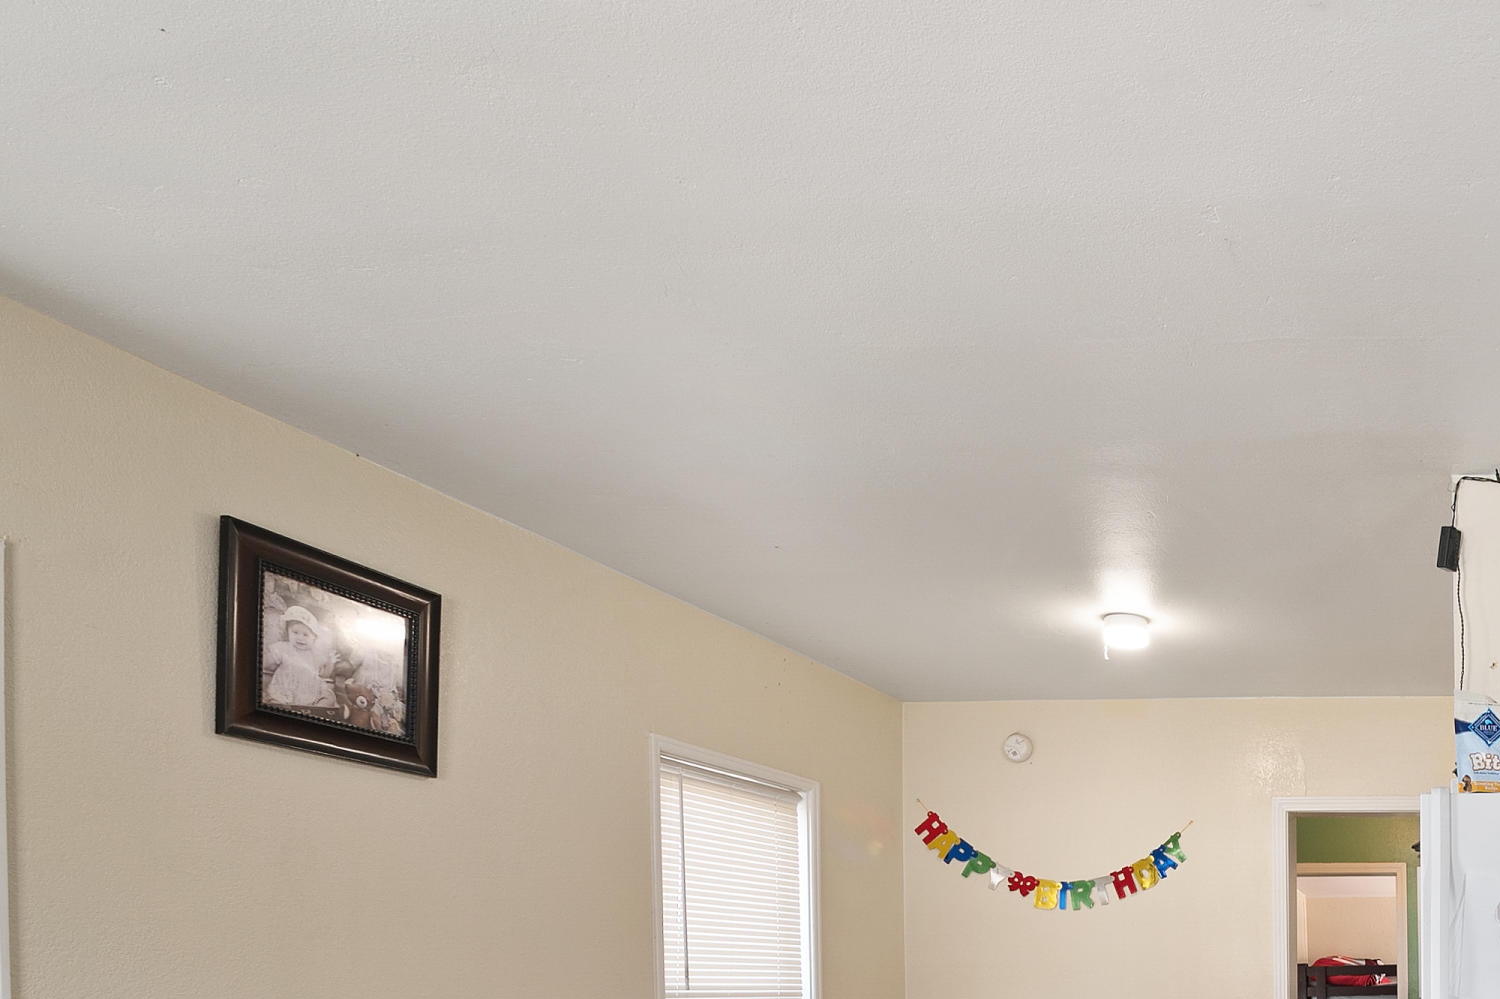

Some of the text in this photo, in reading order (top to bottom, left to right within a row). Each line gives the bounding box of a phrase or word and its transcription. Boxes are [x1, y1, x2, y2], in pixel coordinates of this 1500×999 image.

[1479, 724, 1498, 732] BLUE
[914, 811, 1188, 911] HAPPY BIRTHDAY
